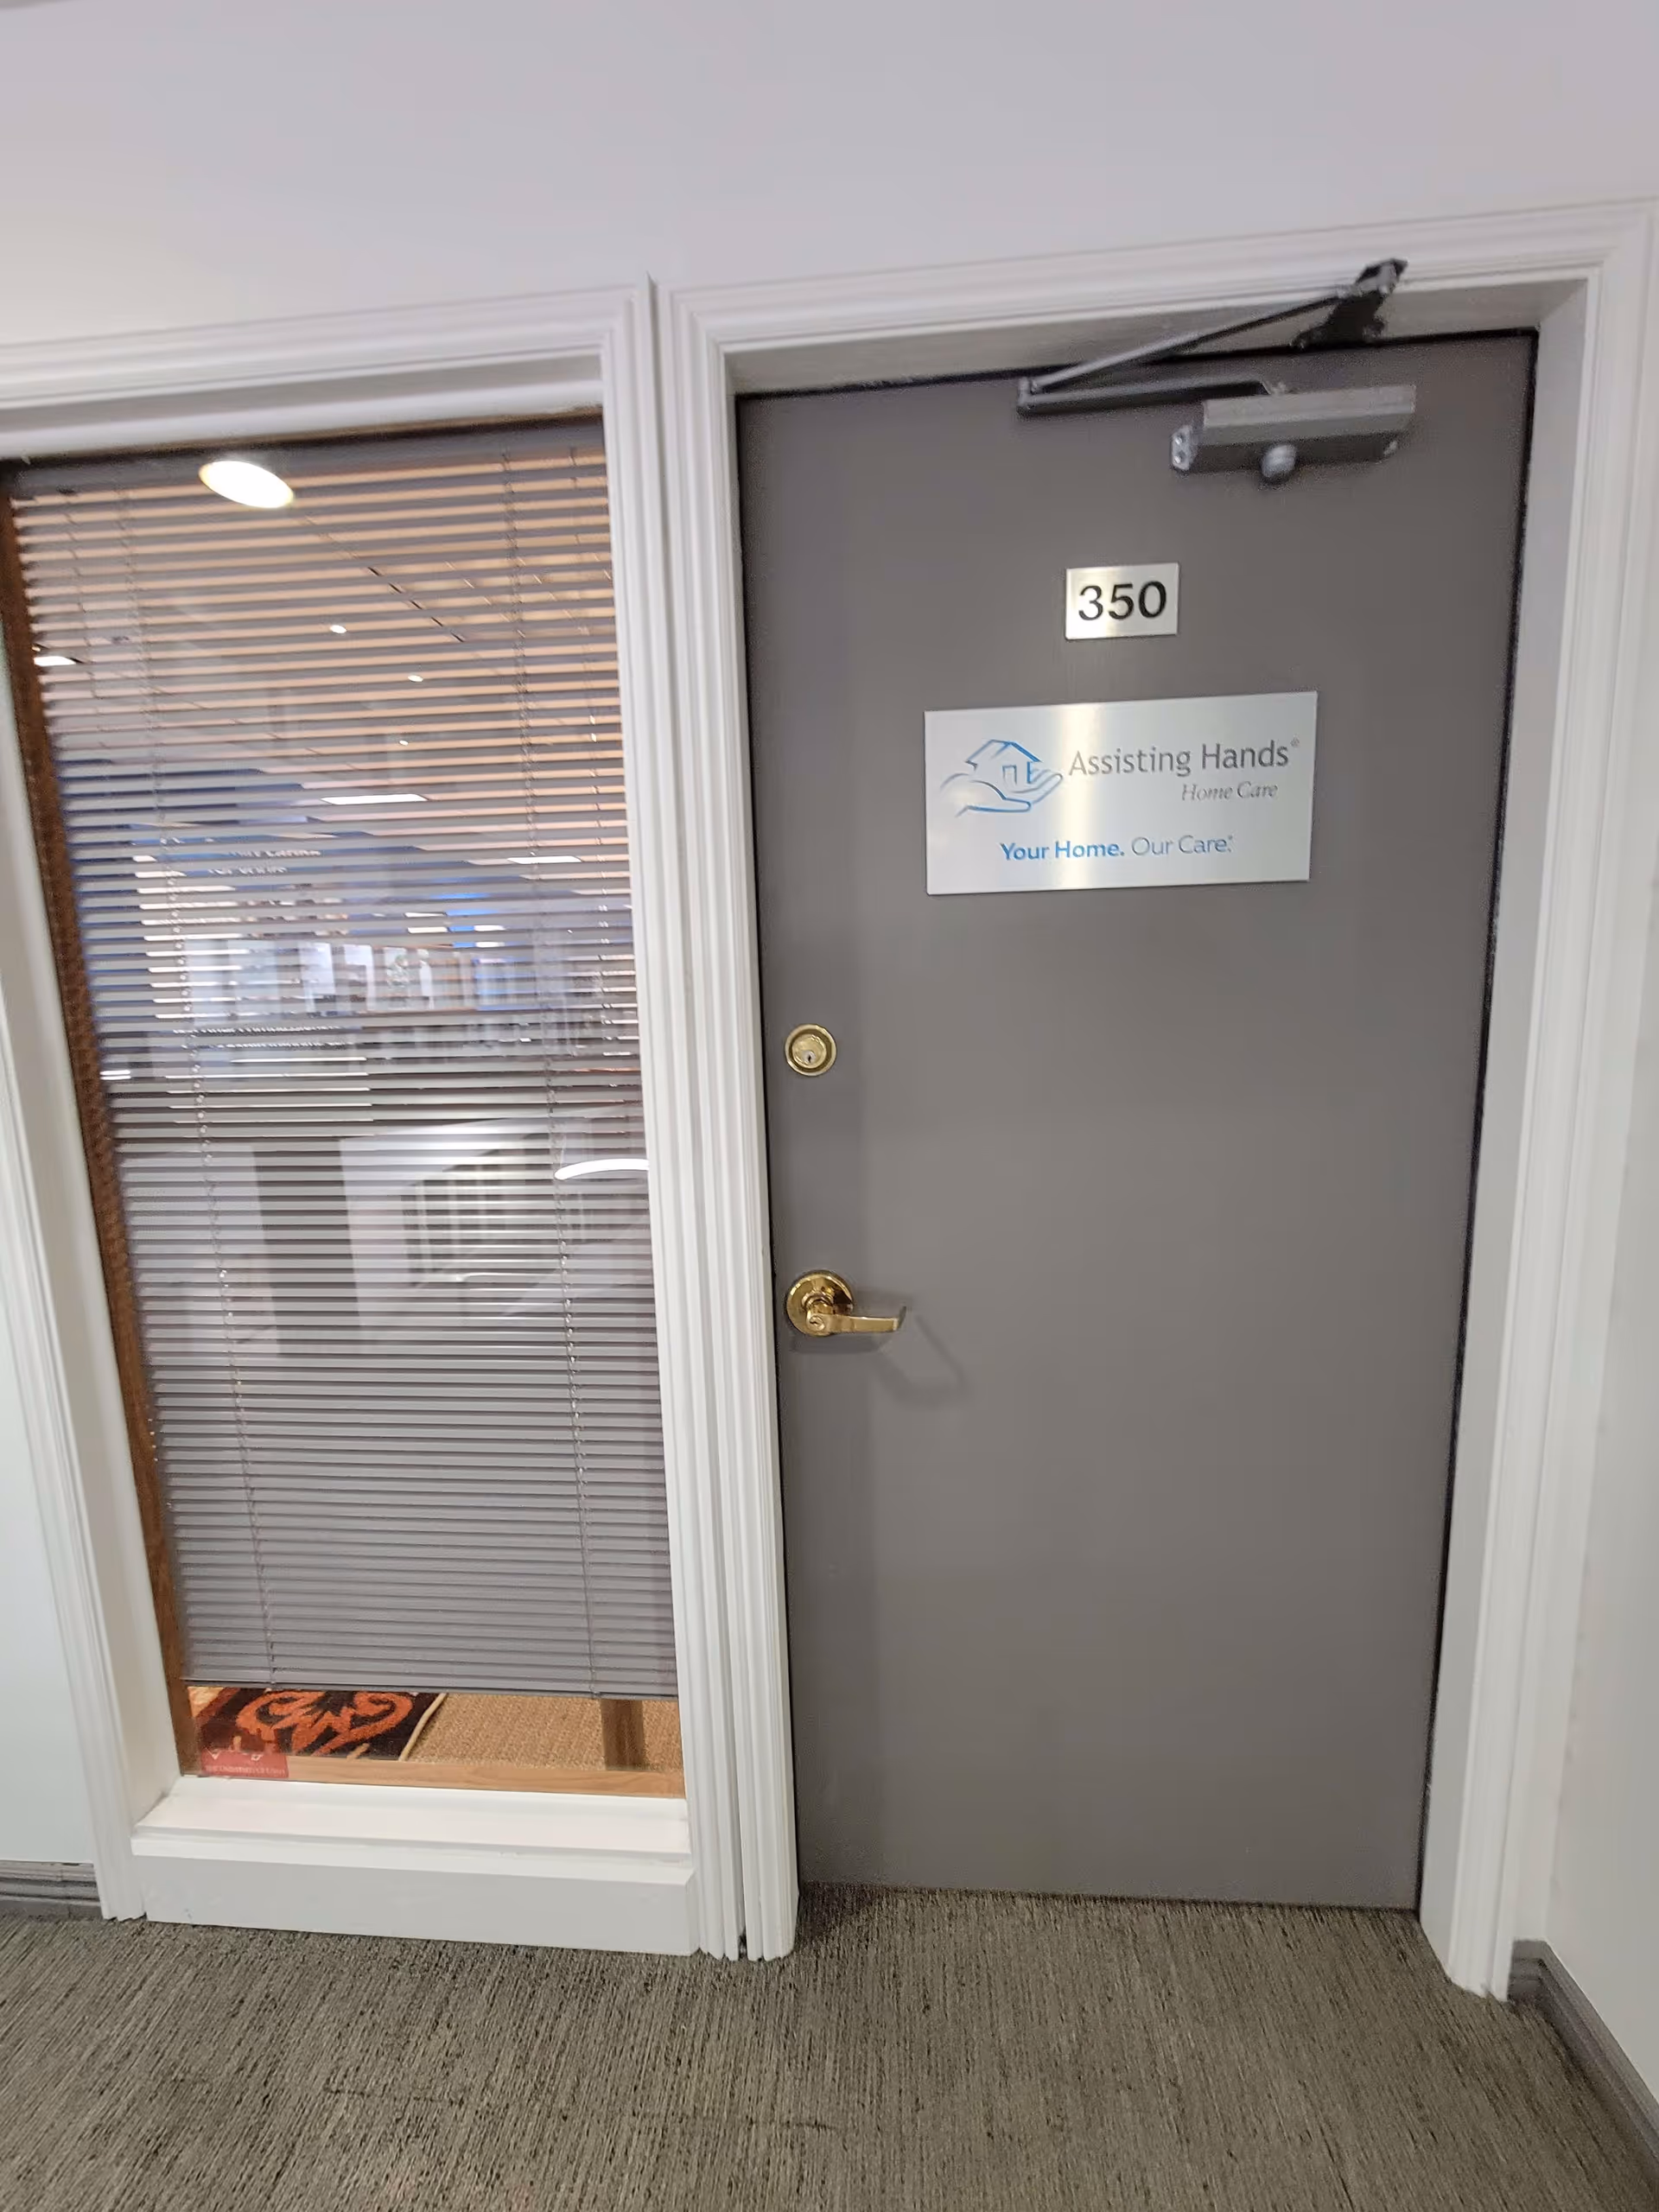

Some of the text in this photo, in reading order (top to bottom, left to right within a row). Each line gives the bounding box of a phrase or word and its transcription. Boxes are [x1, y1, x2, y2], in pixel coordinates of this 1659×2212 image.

[1077, 580, 1167, 621] 350
[1068, 746, 1192, 778] Assisting
[1180, 781, 1278, 801] Home Care
[1000, 842, 1049, 861] Your
[1054, 840, 1125, 859] Home.
[1131, 836, 1173, 855] Our
